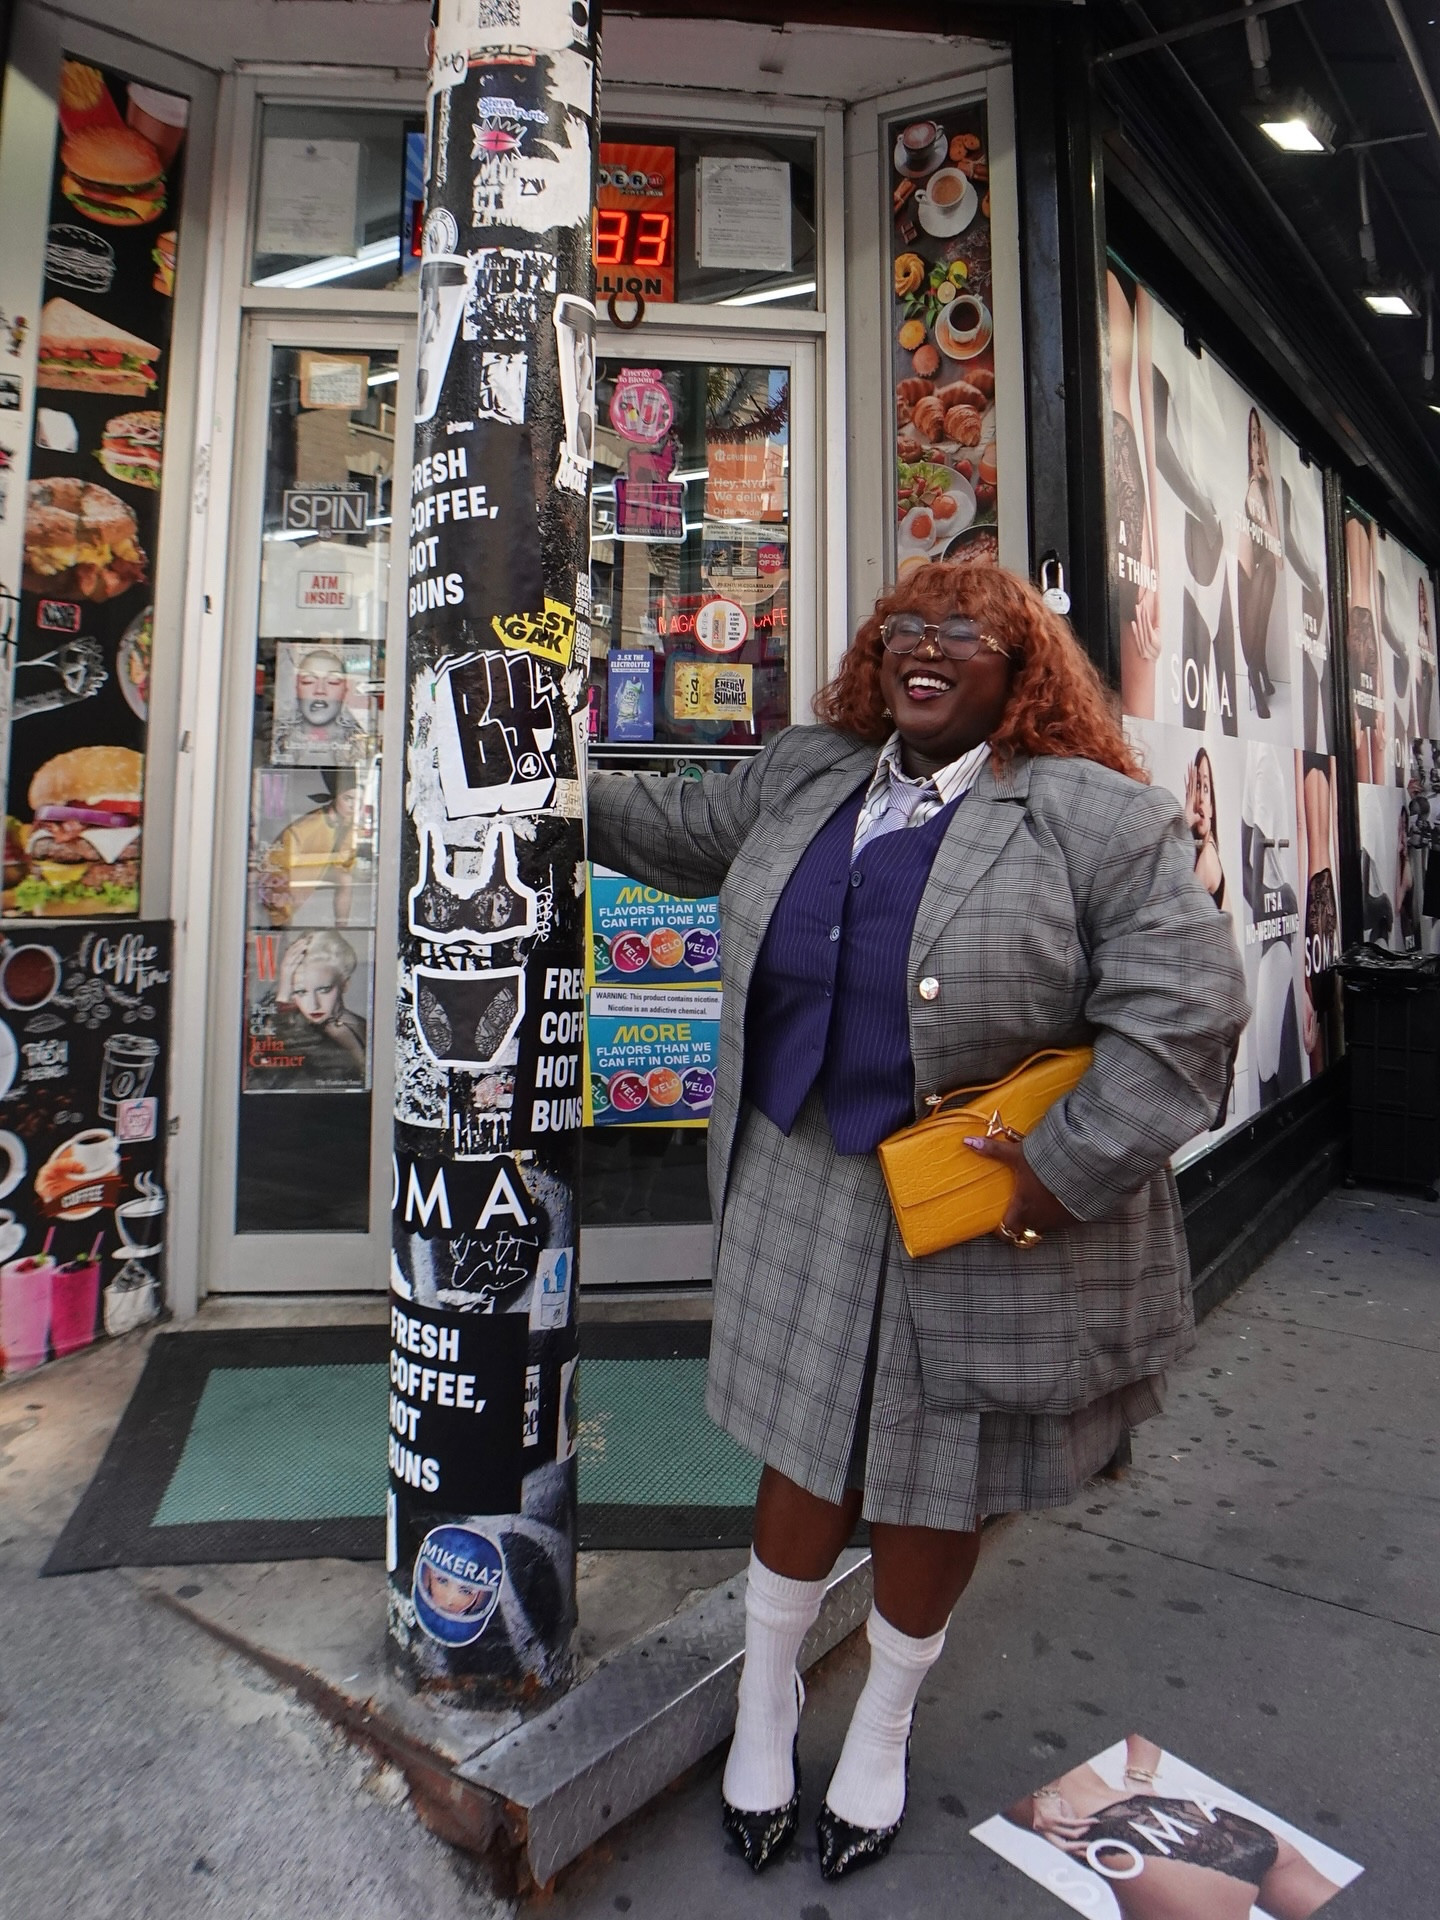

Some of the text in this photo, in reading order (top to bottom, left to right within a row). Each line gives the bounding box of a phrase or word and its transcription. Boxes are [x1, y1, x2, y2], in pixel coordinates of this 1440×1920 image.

[597, 277, 662, 295] LION
[628, 376, 655, 385] Bloom
[288, 495, 364, 530] SPIN
[1119, 520, 1127, 546] A
[409, 536, 439, 577] HOT
[311, 575, 338, 590] ATM
[1126, 557, 1158, 593] THING
[304, 592, 345, 606] INSIDE
[409, 573, 464, 618] BUNS
[506, 621, 562, 654] GAK
[714, 679, 745, 692] ENERGY
[1170, 653, 1233, 718] SOMA
[714, 691, 747, 705] SUMMER
[616, 886, 697, 905] MO
[1264, 891, 1283, 913] IT'S A
[599, 903, 717, 917] FLAVORS THAN WE
[601, 915, 715, 928] CAN FIT IN ONE AD
[1246, 913, 1300, 945] NO-WEDGIE THING
[593, 944, 610, 965] ELO
[623, 942, 644, 966] VELO
[654, 938, 682, 953] VELO
[686, 941, 714, 956] VELO
[1305, 929, 1341, 977] SOMA
[92, 934, 158, 985] Coffee
[253, 934, 282, 982] W
[596, 992, 629, 1000] WARNING:
[643, 994, 666, 1003] product
[694, 995, 720, 1003] nicotine.
[607, 1004, 633, 1012] Nicotine
[649, 1006, 677, 1014] addictive
[678, 1007, 707, 1015] chemical.
[613, 1023, 692, 1043] MORE
[250, 1036, 285, 1051] Julia
[596, 1042, 711, 1056] FLAVORS THAN WE
[250, 1052, 306, 1068] Garner
[598, 1053, 711, 1067] CAN FIT IN ONE AD
[535, 1055, 578, 1088] HOT
[591, 1085, 608, 1105] ELO
[620, 1081, 642, 1105] VELO
[651, 1077, 680, 1094] VELO
[684, 1080, 712, 1094] VELO
[531, 1096, 582, 1132] BUNS
[390, 1305, 460, 1363] FRESH
[389, 1349, 487, 1413] COFFEE,
[1046, 1788, 1226, 1907] SOMA
